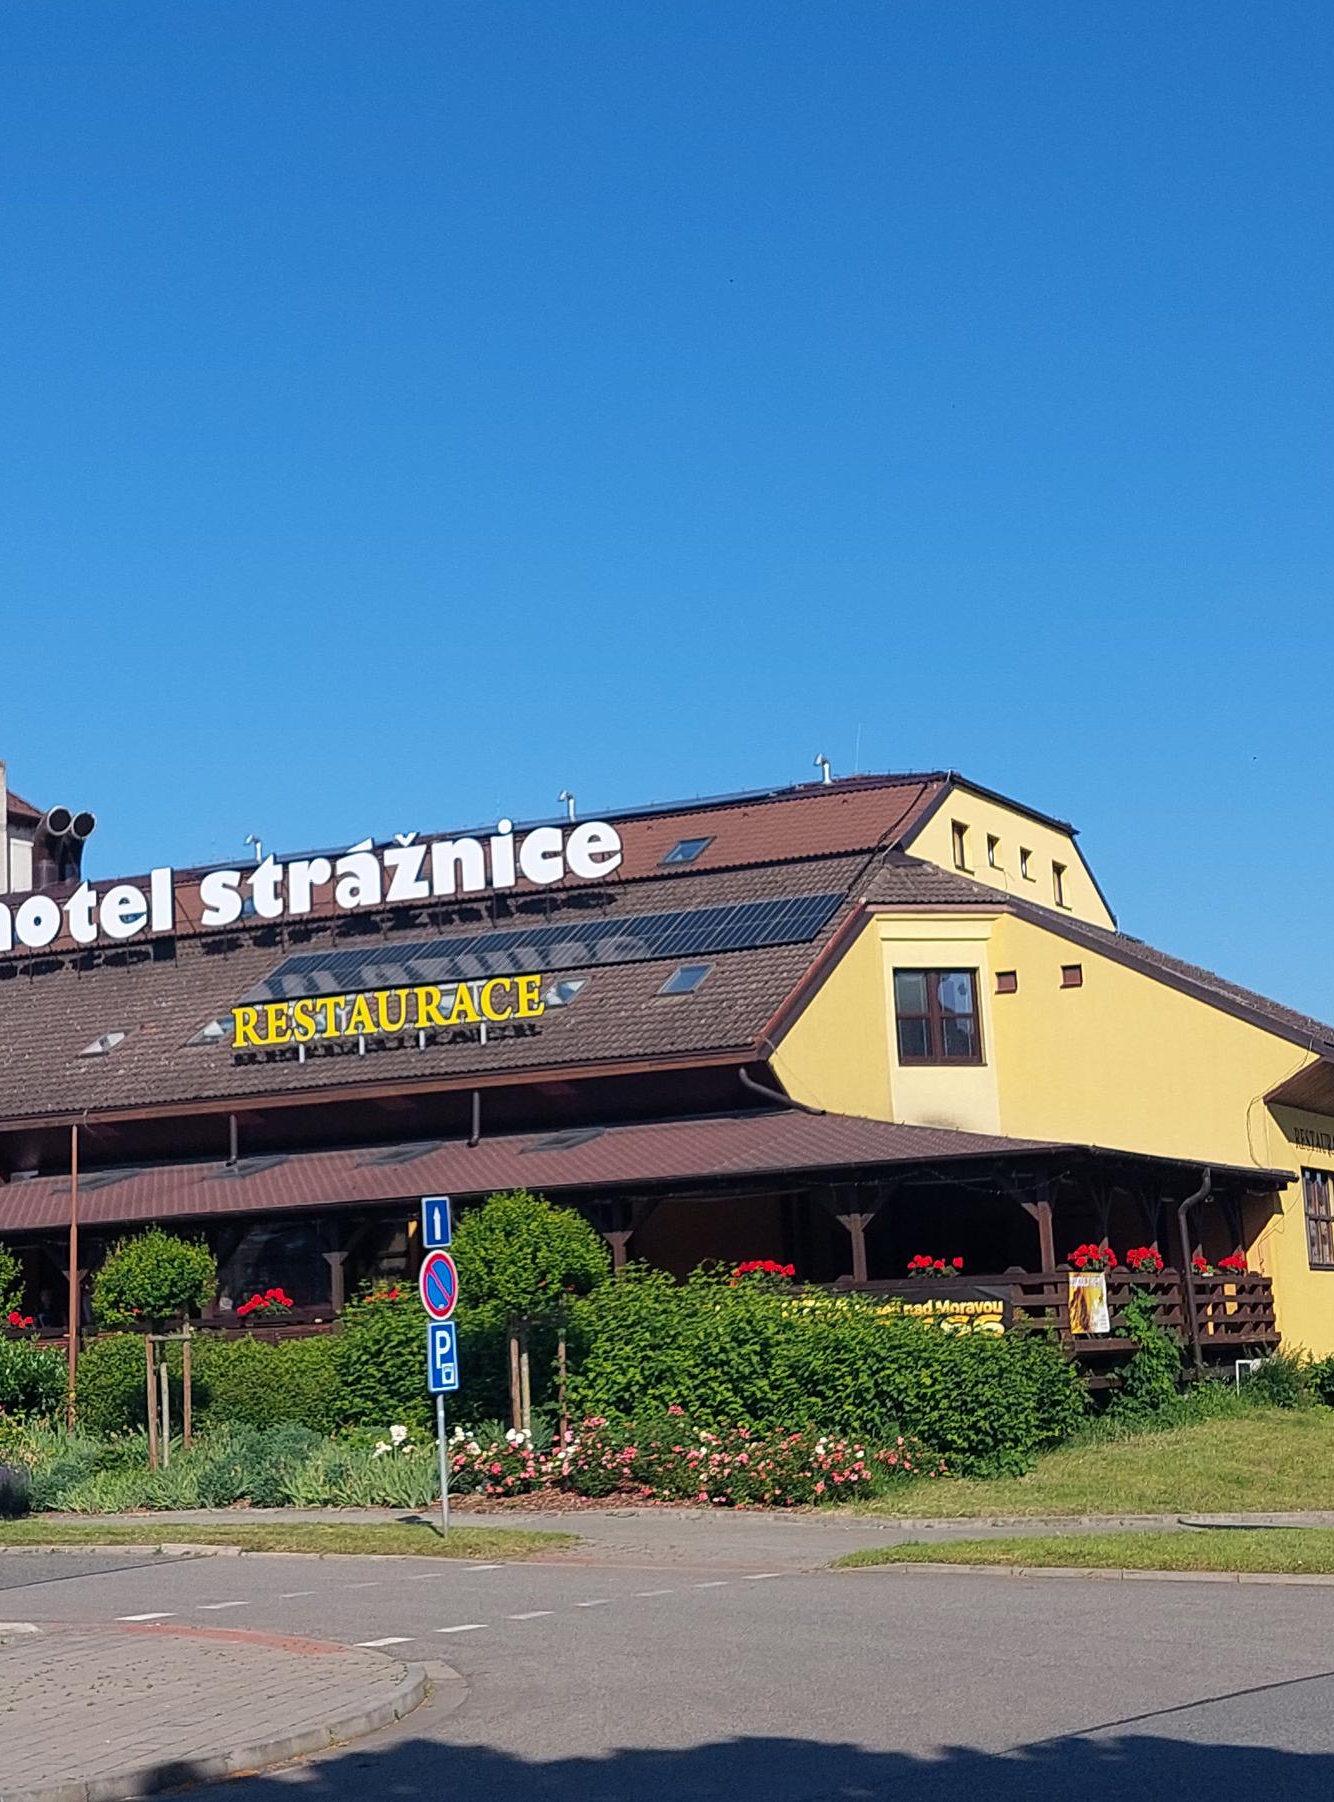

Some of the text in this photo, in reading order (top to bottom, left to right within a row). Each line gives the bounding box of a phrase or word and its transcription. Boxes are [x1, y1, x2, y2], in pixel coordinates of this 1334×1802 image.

[200, 818, 623, 927] strážnice
[231, 974, 544, 1048] RESTAURACE
[935, 1299, 1004, 1315] Moravou
[435, 1330, 451, 1369] P
